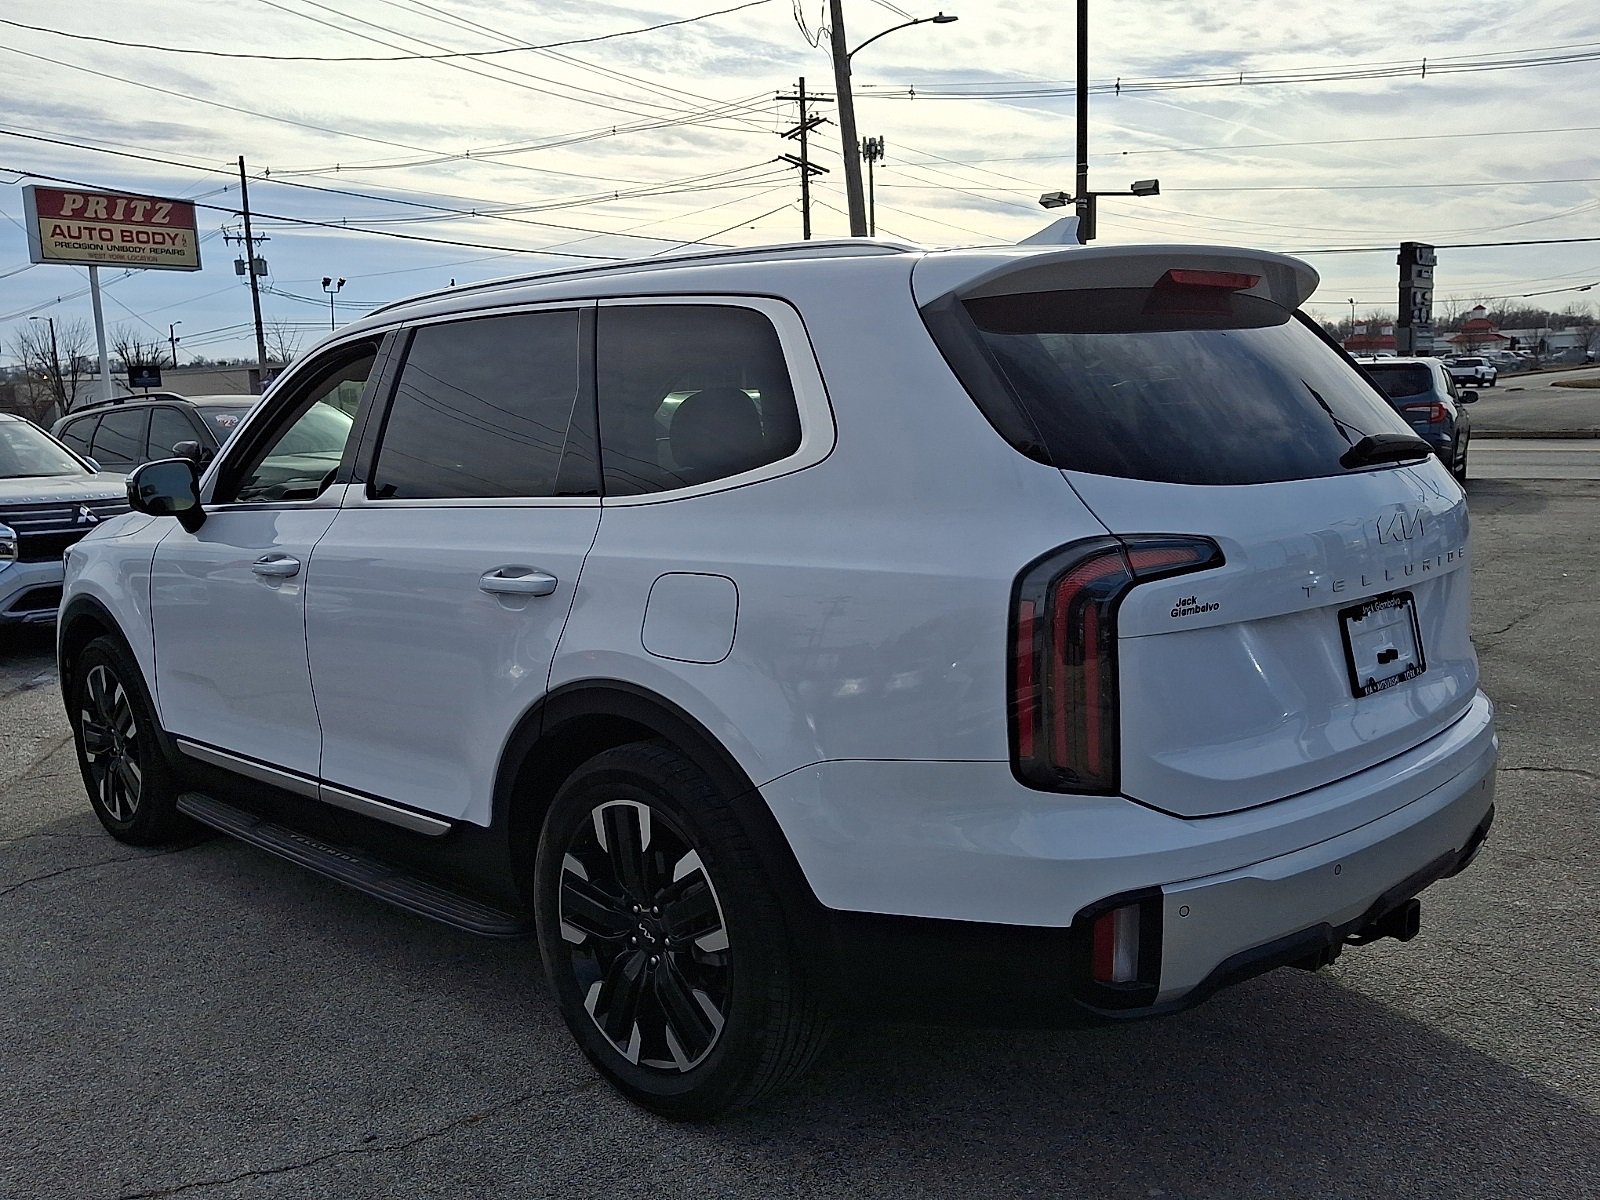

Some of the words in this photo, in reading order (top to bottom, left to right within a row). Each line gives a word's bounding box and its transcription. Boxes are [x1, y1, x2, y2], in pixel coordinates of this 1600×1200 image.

[60, 193, 173, 224] PRITZ
[50, 223, 114, 242] AUTO
[119, 229, 180, 246] BODY
[54, 241, 104, 252] PRECISION
[106, 244, 146, 255] UNIBODY
[149, 247, 186, 256] REPAIRS
[108, 253, 126, 261] YORK
[127, 254, 158, 263] LOCATION
[1302, 545, 1465, 599] TELLURIDE
[1175, 595, 1198, 608] Jack
[1170, 602, 1220, 618] Giambalvo
